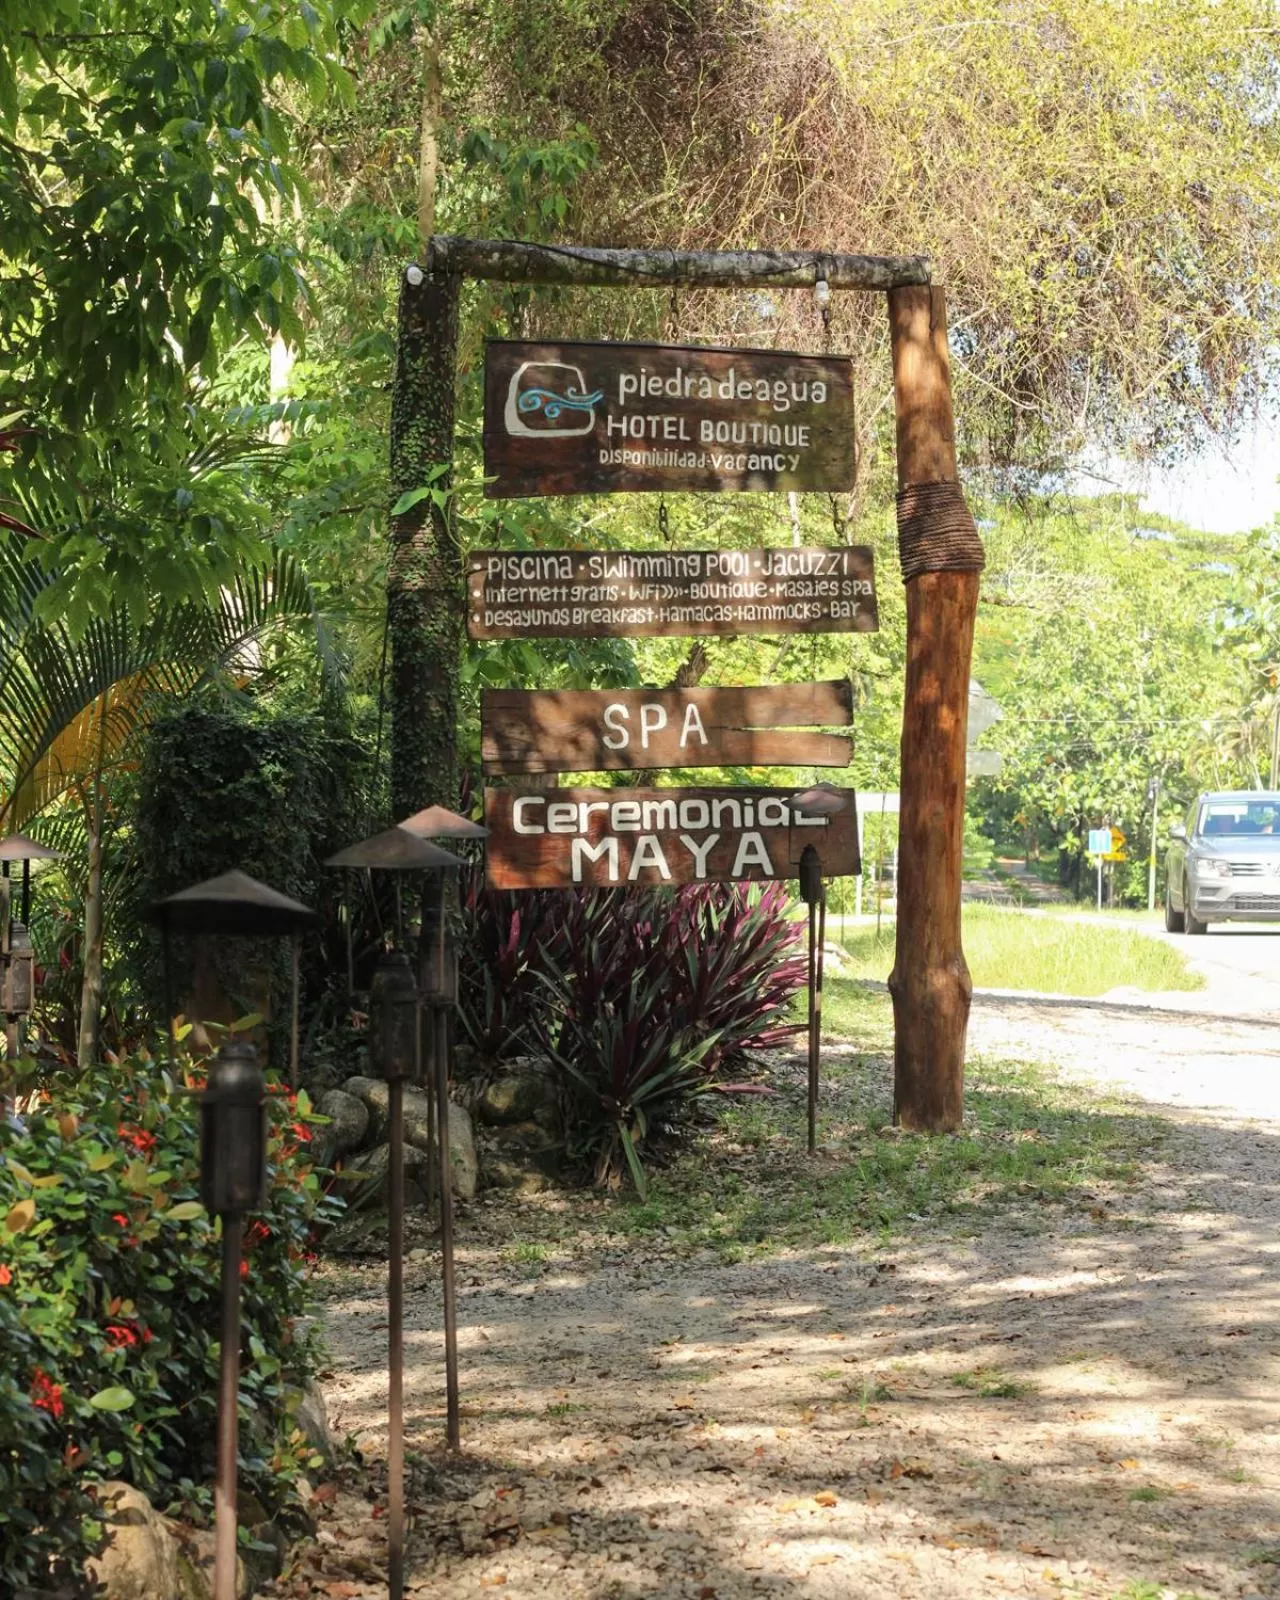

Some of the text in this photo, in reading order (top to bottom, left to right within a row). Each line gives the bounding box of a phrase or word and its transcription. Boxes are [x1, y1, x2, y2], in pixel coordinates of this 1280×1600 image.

[607, 415, 811, 448] HOTEL BOUTIQUE
[602, 703, 709, 750] SPA
[571, 831, 775, 883] MAYA
